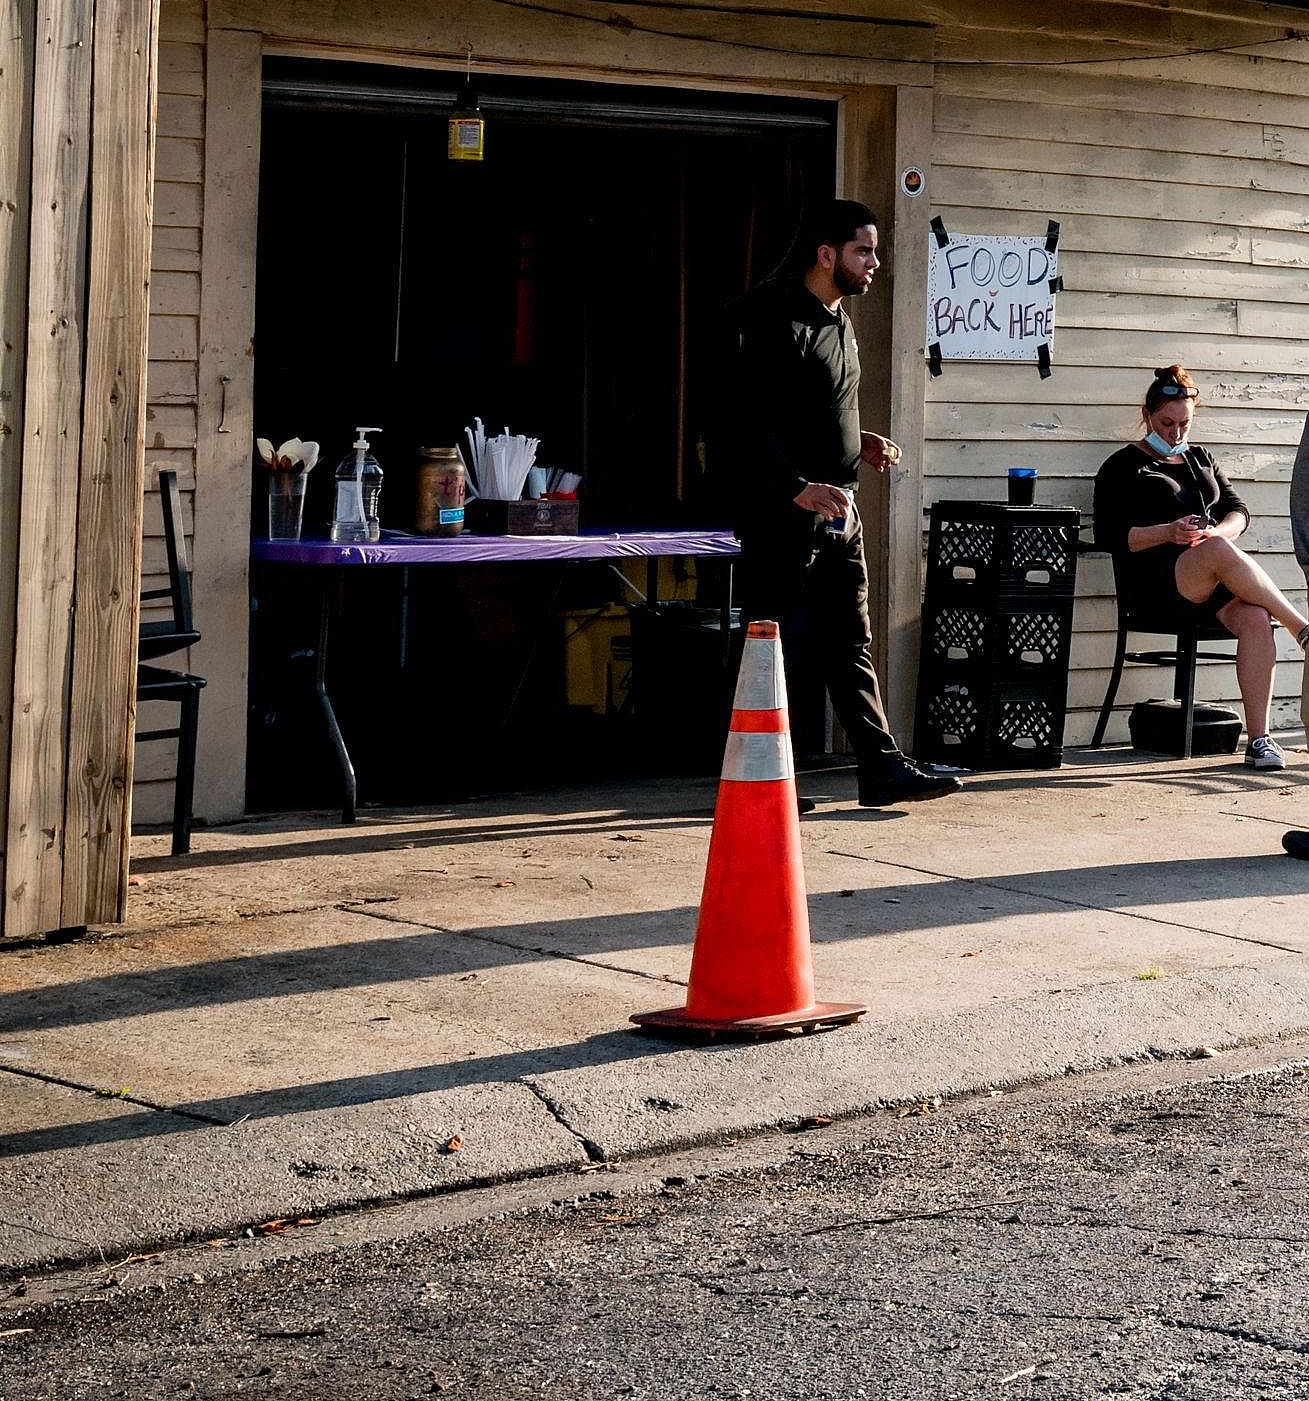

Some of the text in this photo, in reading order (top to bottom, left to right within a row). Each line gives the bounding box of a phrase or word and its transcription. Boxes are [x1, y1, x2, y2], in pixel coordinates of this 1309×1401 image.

[945, 244, 1050, 290] FOOD
[933, 296, 1054, 340] BACK HERE
